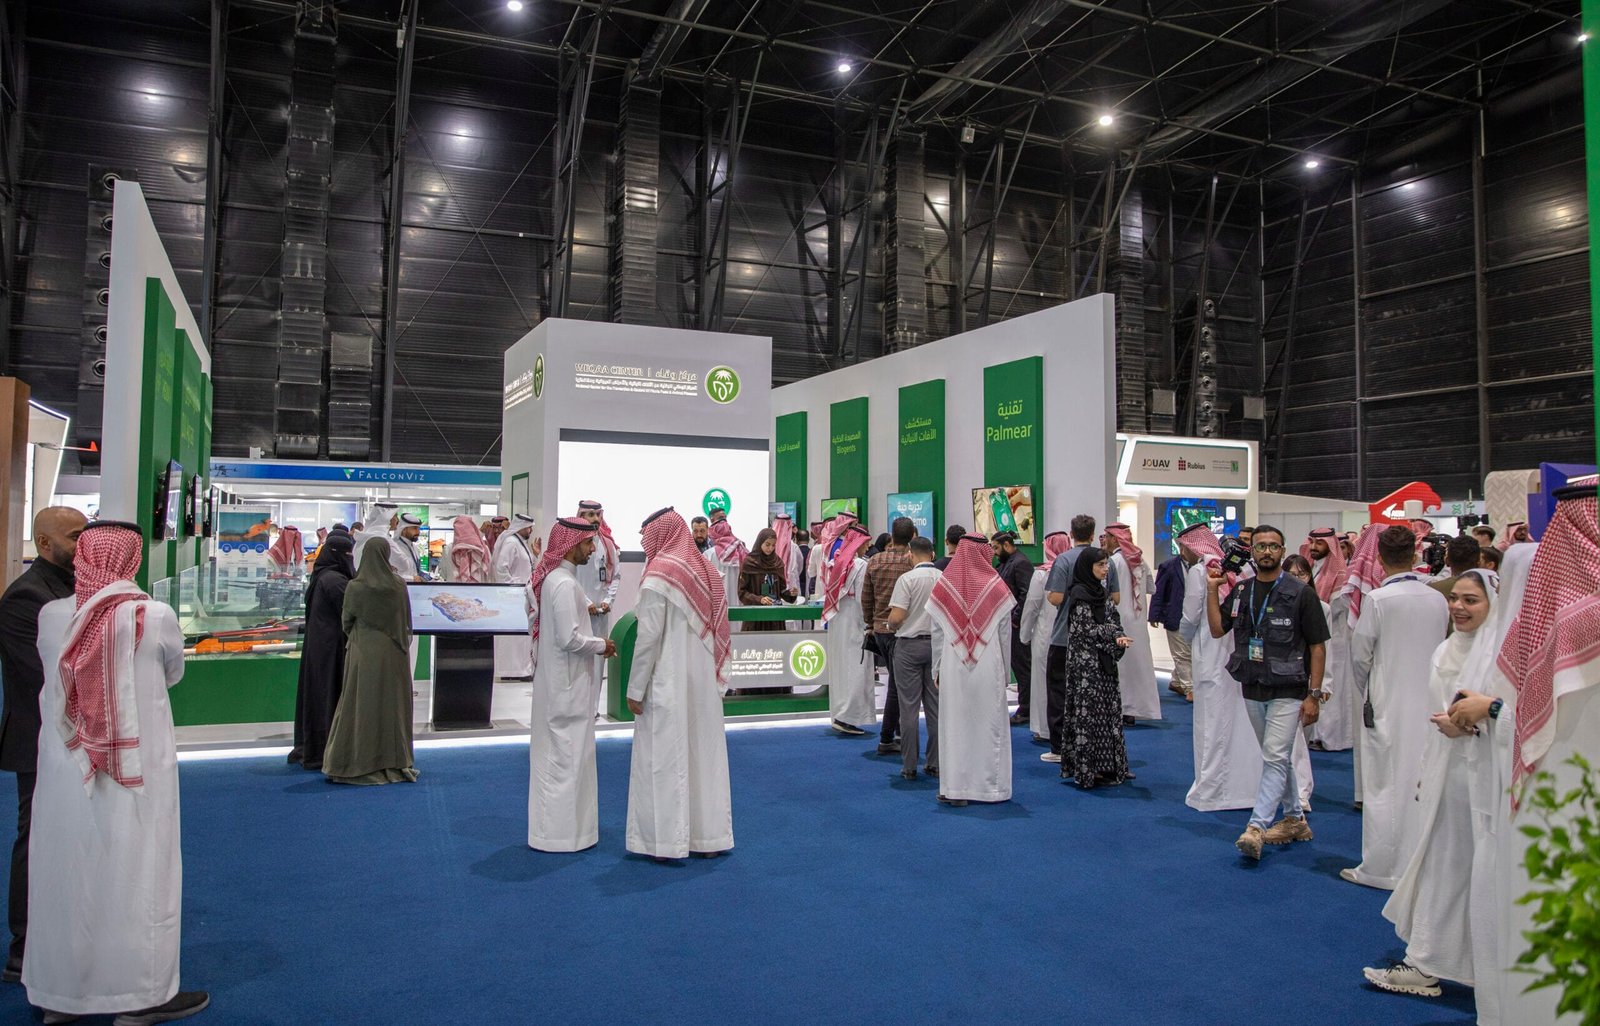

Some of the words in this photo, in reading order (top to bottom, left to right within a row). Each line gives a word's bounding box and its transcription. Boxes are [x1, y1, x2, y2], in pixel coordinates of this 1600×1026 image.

[998, 400, 1023, 419] تقنية
[987, 424, 1032, 442] Palmear
[1142, 458, 1170, 468] JOUAV
[1187, 462, 1206, 470] Rubius
